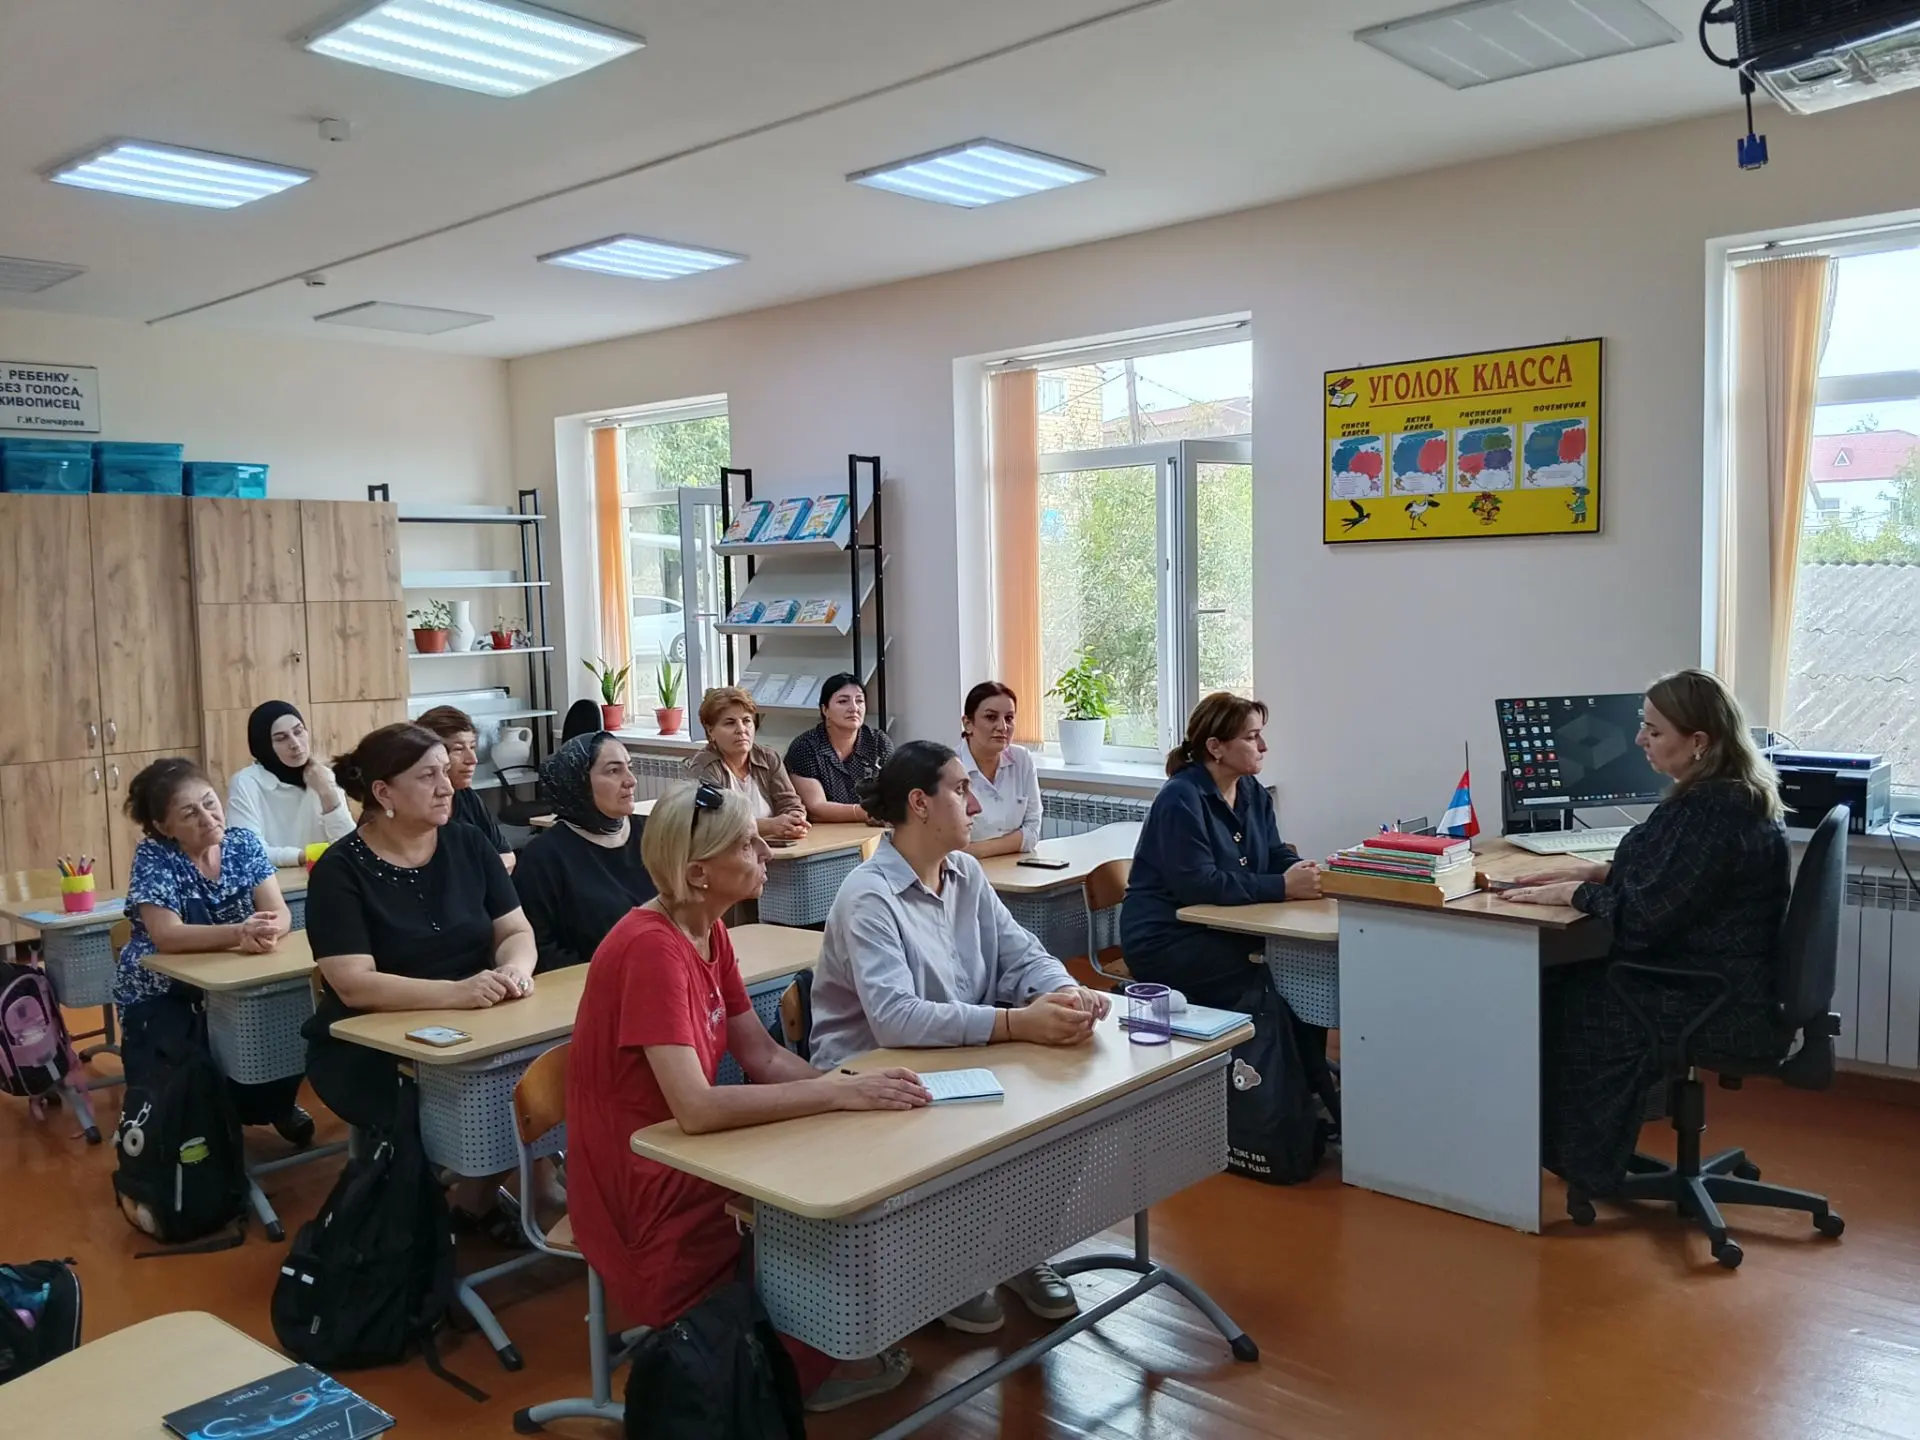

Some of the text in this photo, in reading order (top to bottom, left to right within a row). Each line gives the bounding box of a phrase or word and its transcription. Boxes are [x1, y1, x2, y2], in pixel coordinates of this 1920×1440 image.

[9, 370, 69, 382] РЕБЕНКУ
[1368, 354, 1572, 404] УГОЛОК КЛАССА
[26, 384, 83, 397] ГОЛОСА,
[1533, 401, 1587, 412] ПОЧЕМУЧКА
[1459, 407, 1512, 418] РАСПИСАНИЕ
[1341, 421, 1370, 430] СПИСОК
[1403, 423, 1434, 431] КЛАССА
[1469, 417, 1502, 426] УРОКОВ
[1341, 429, 1370, 437] КЛАССА
